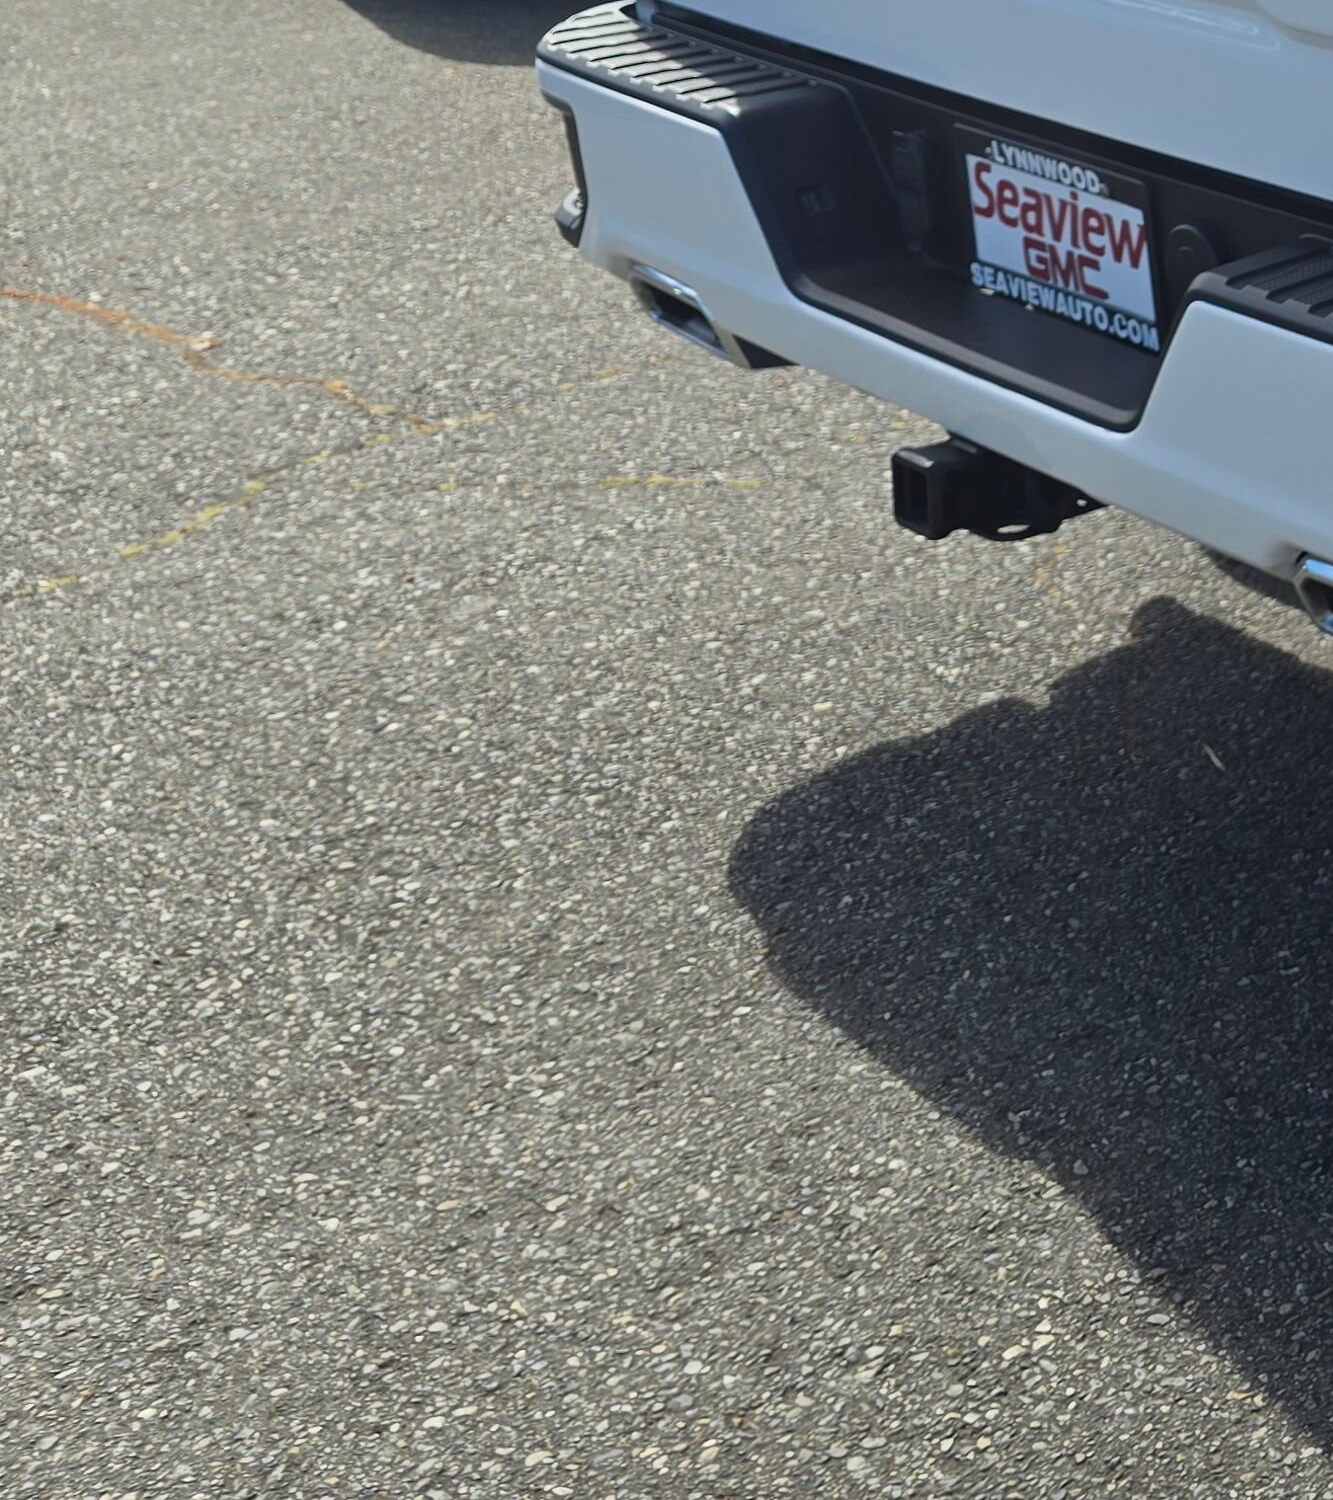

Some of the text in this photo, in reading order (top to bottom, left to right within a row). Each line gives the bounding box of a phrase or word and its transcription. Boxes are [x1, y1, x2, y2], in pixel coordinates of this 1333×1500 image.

[991, 140, 1101, 194] LYNNWOOD
[974, 161, 1147, 270] Seaview
[969, 261, 1160, 352] SEAVIEWAUTO.COM
[1023, 236, 1110, 301] GMC
